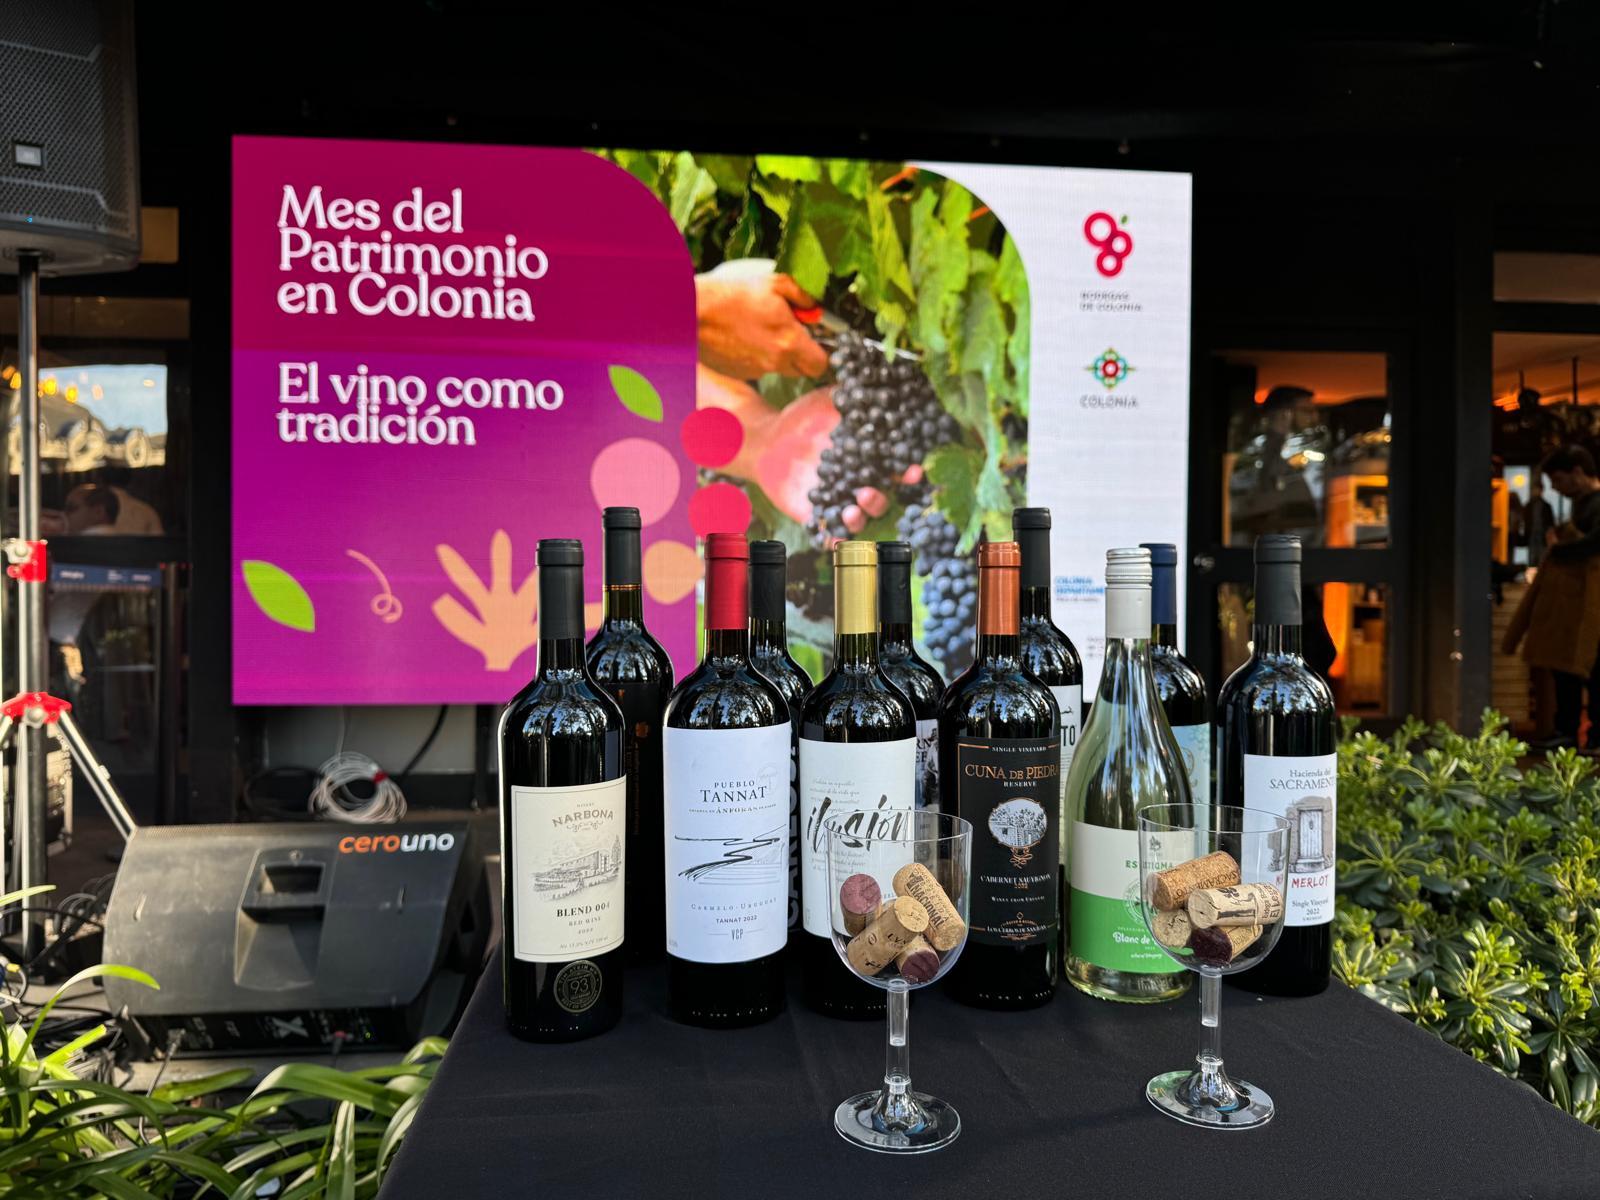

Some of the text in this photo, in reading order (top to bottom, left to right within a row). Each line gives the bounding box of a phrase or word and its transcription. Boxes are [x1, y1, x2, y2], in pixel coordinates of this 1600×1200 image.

[277, 184, 464, 233] Mes del
[279, 226, 549, 280] Patrimonio
[277, 271, 536, 321] en Colonia
[278, 361, 565, 410] El vino como
[1079, 395, 1139, 409] COLONIA
[276, 402, 477, 446] tradición
[965, 763, 1007, 779] CUNA
[1009, 770, 1024, 780] DE
[1289, 768, 1323, 778] Hacienda
[714, 780, 755, 789] PUEBLO
[699, 785, 767, 803] TANNAT
[552, 809, 614, 828] NARBONA
[338, 833, 455, 854] cerouno
[980, 875, 1018, 884] CABERNET
[1291, 874, 1329, 888] MERLOT
[557, 905, 592, 917] BLEND
[690, 903, 734, 911] CARMELO
[910, 884, 945, 929] NACIONAL
[1112, 931, 1140, 945] Blanc
[1140, 935, 1151, 945] de
[570, 977, 589, 995] 93
